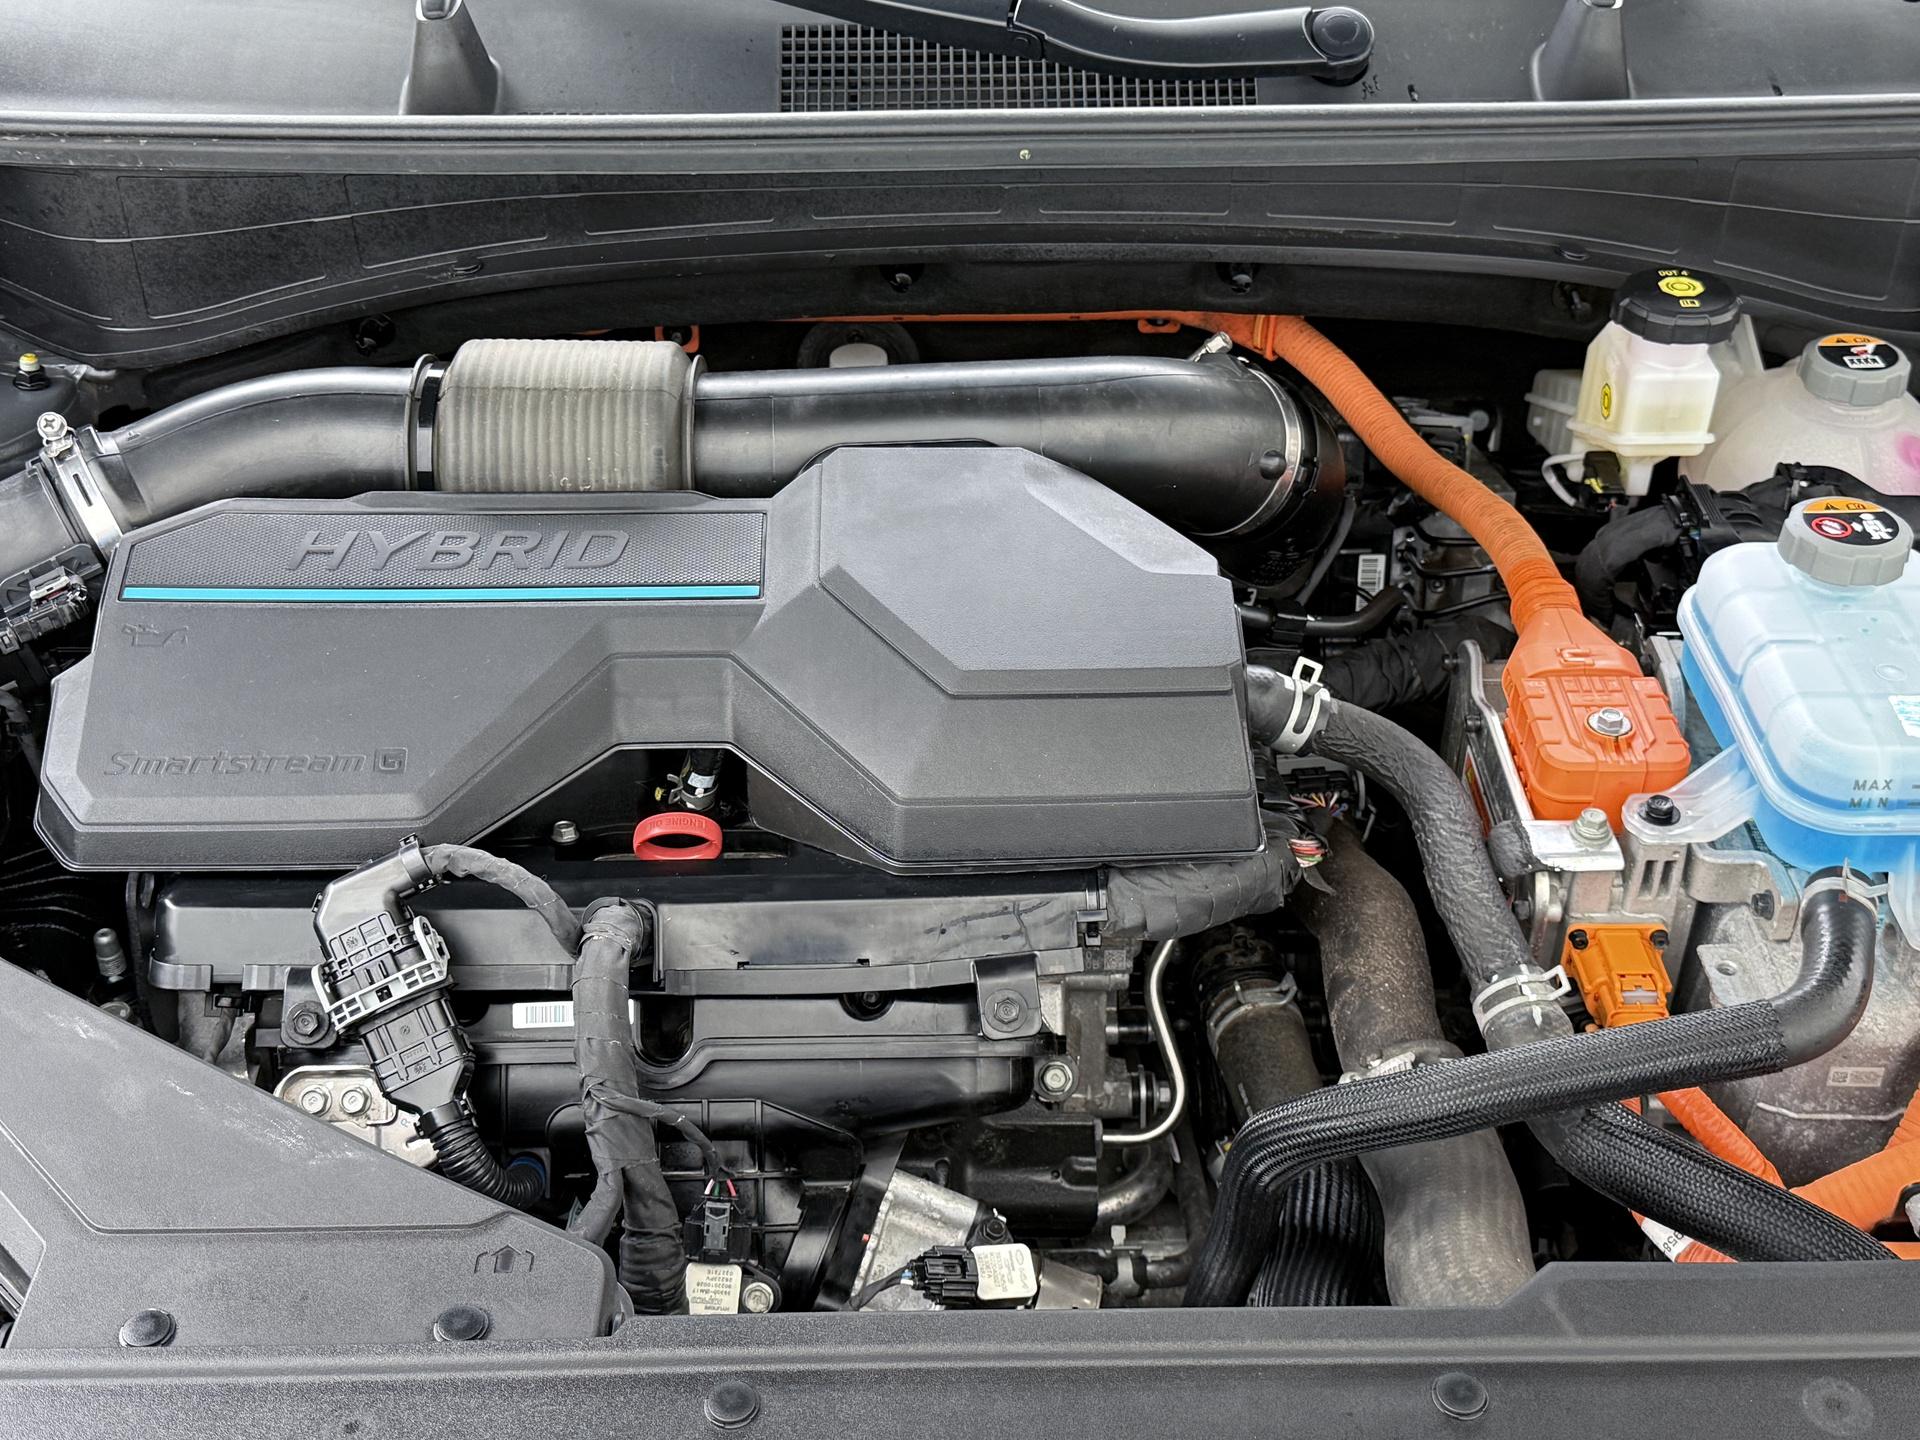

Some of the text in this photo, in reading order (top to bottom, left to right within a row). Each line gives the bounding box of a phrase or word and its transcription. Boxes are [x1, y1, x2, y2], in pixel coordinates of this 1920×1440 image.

[1657, 269, 1678, 277] DOT
[285, 529, 631, 571] HYBRID
[103, 749, 368, 776] Smartstream
[1852, 778, 1894, 791] MAX
[1848, 797, 1890, 809] MIN
[648, 816, 707, 831] ENGINE OIL
